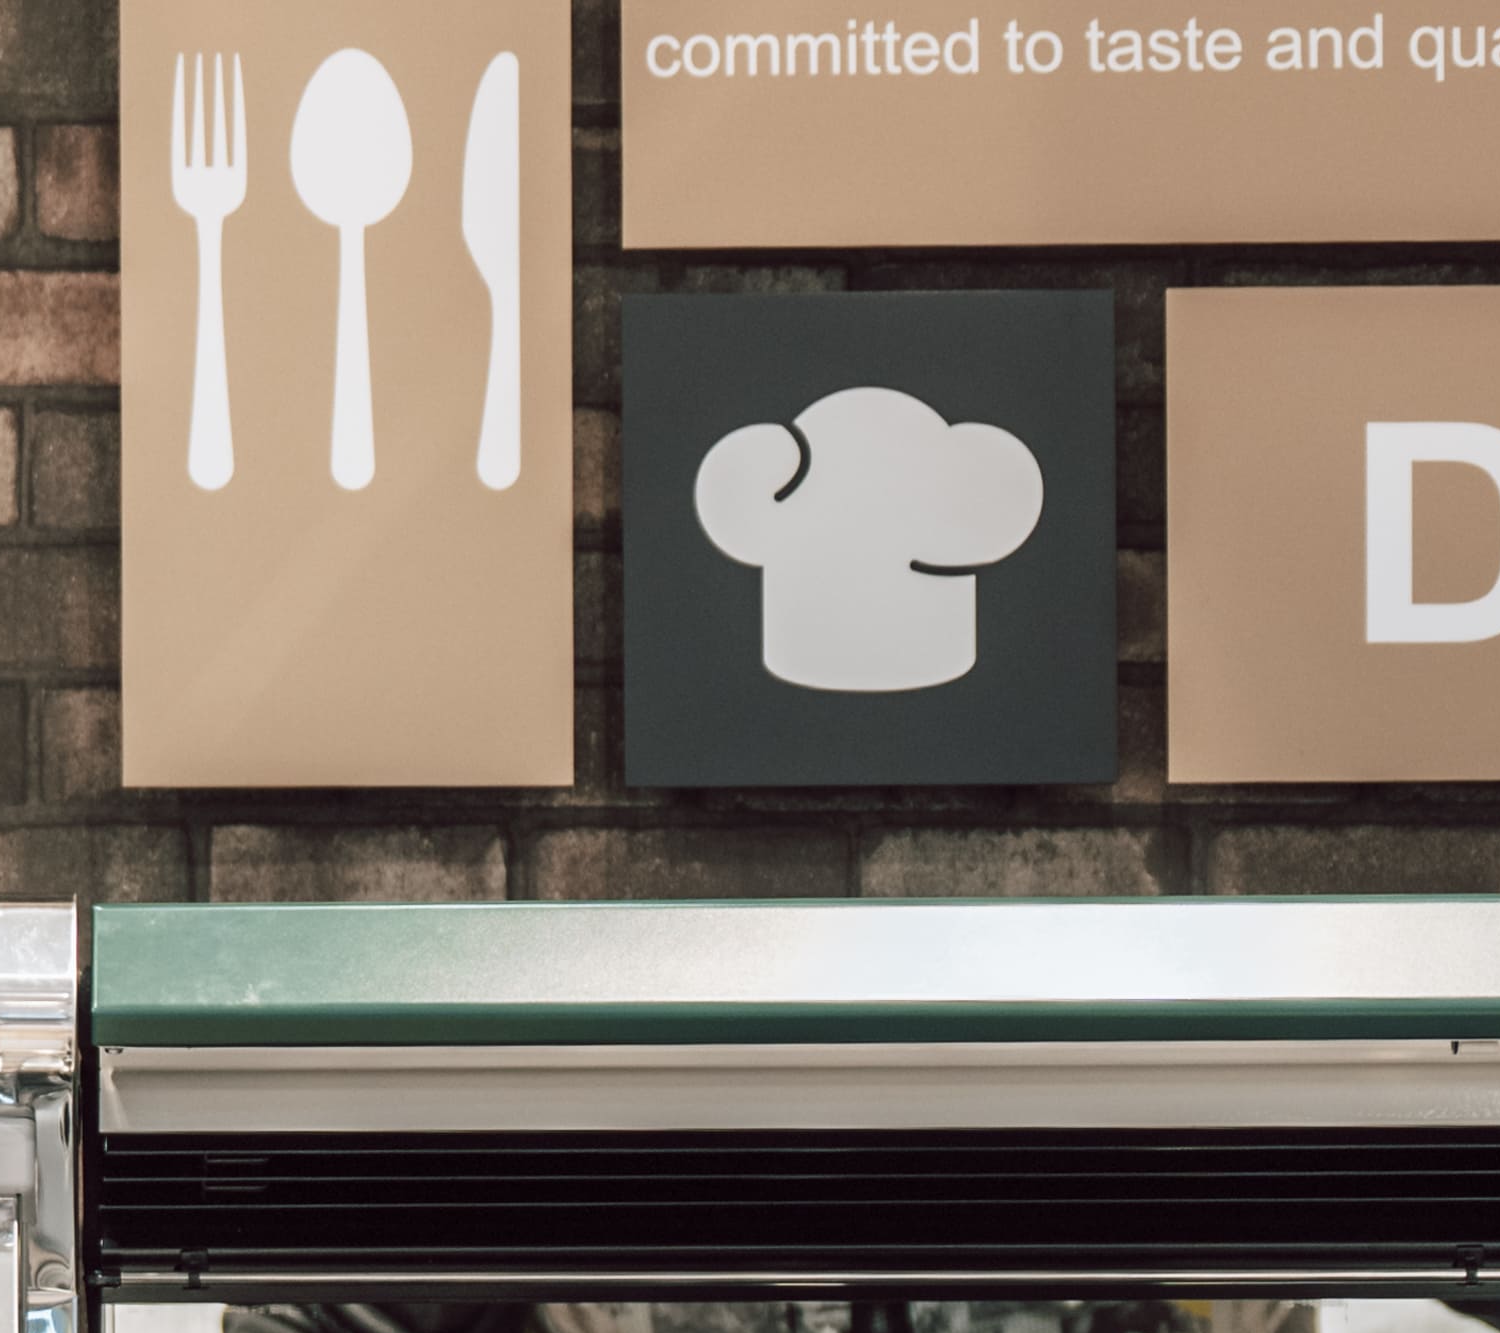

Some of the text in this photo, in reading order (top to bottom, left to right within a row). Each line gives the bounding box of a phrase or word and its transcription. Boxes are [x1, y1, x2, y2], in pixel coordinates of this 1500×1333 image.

[645, 19, 980, 78] committed
[1004, 22, 1064, 74] to
[1085, 18, 1243, 73] taste
[1266, 13, 1384, 71] and
